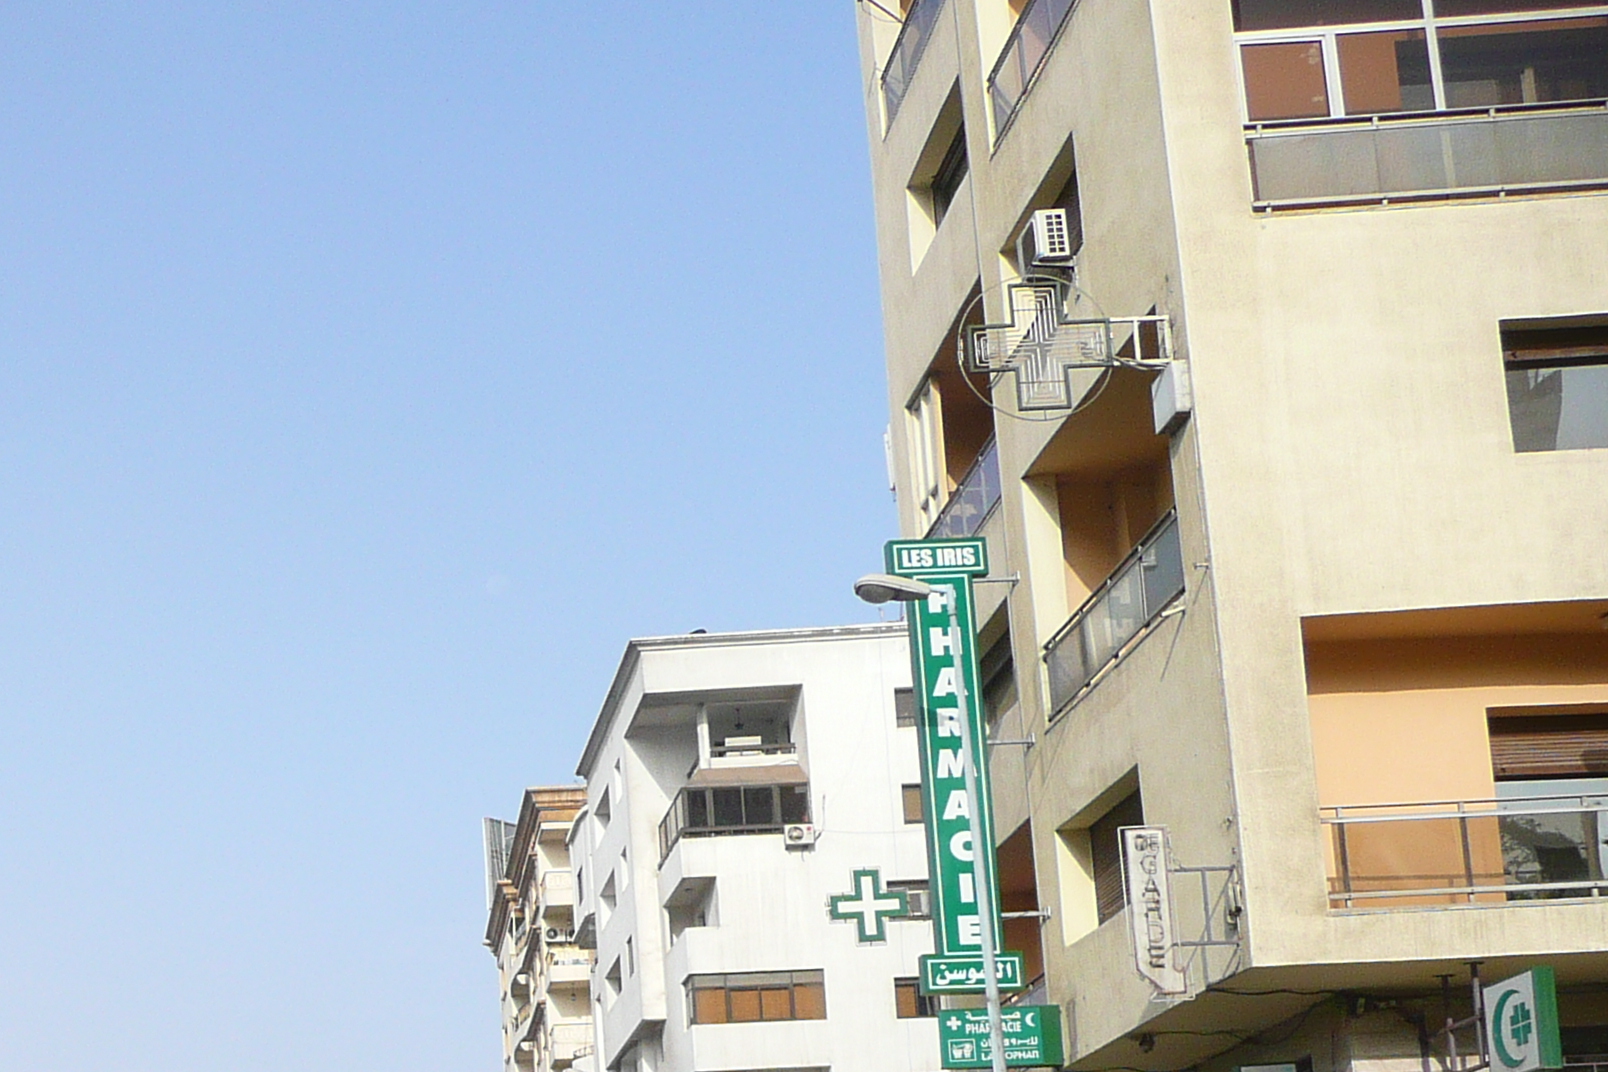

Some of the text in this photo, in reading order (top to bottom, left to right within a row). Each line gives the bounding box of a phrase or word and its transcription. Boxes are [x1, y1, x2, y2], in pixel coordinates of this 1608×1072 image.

[901, 547, 975, 568] LES IRIS
[935, 961, 1012, 985] الوسن
[964, 1021, 1022, 1035] PHAACIE
[980, 1049, 1040, 1062] LAOPHAN
